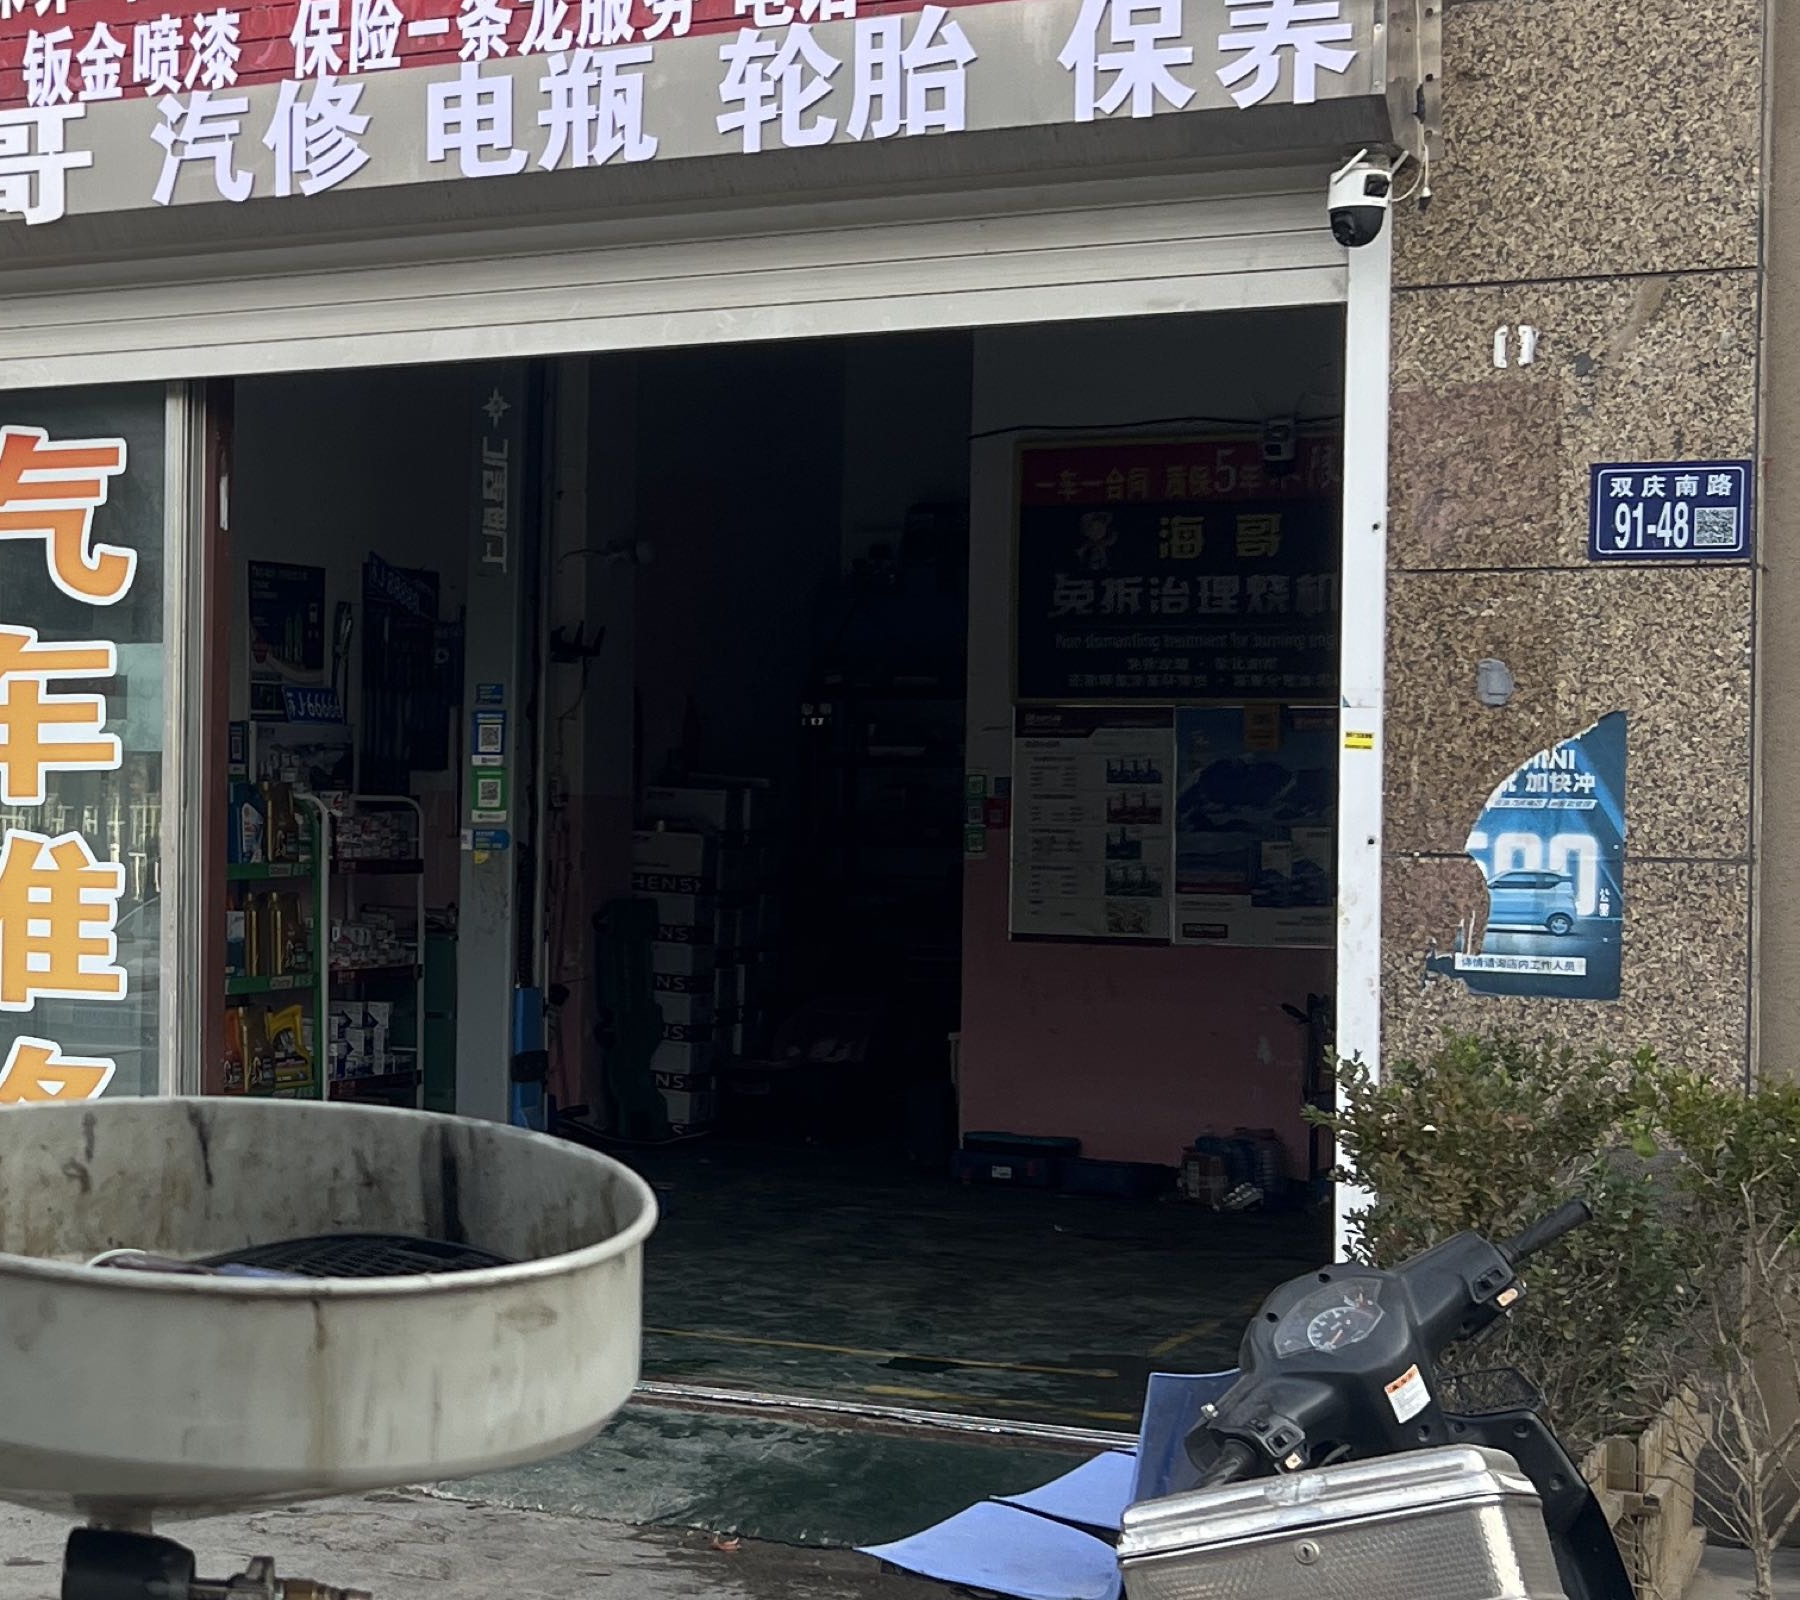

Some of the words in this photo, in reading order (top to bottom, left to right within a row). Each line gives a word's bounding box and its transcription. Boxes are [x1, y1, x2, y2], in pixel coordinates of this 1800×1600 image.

[23, 6, 243, 109] 钣金喷漆
[150, 75, 373, 208] 汽修
[426, 44, 658, 179] 电瓶
[716, 5, 977, 155] 轮胎
[1609, 473, 1733, 497] 双庆南路
[1614, 501, 1689, 549] 91-48
